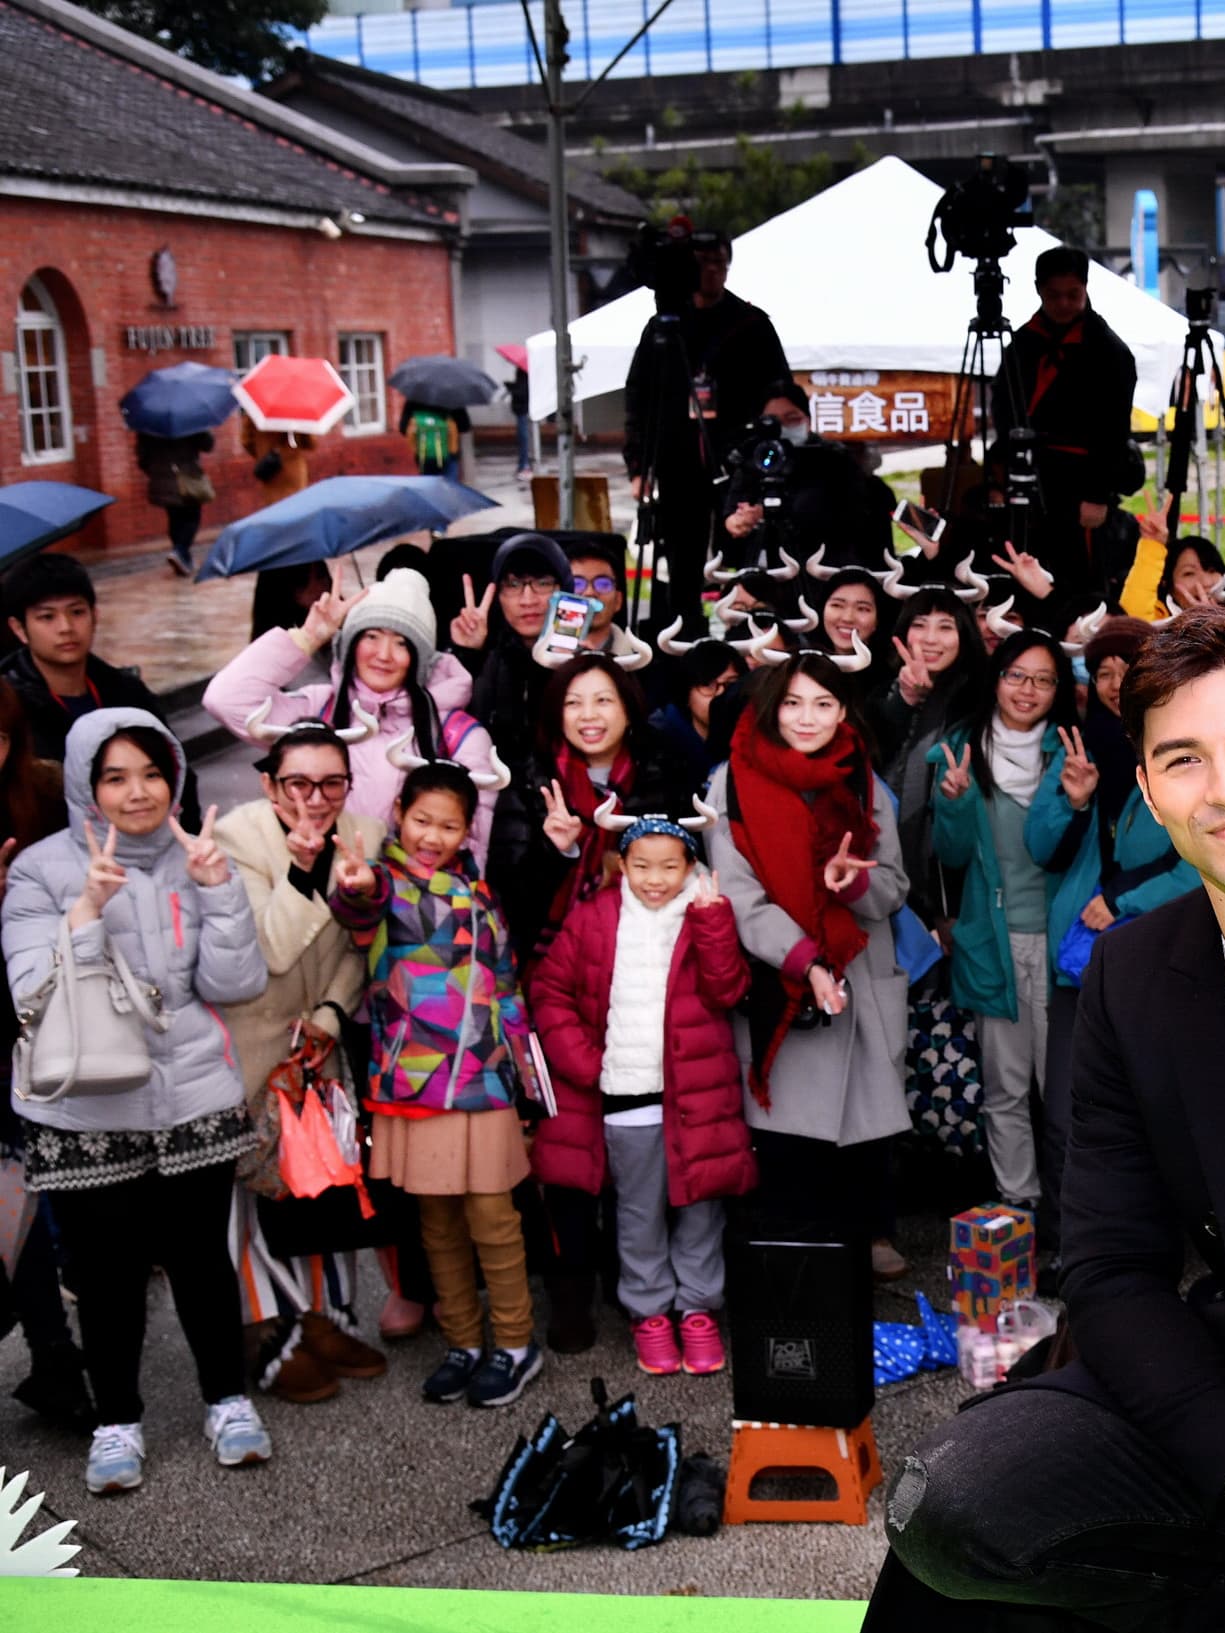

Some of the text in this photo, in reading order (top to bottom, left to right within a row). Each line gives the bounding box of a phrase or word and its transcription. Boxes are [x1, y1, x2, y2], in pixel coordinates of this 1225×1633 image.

[179, 325, 215, 349] TREE
[809, 391, 929, 433] 信食品
